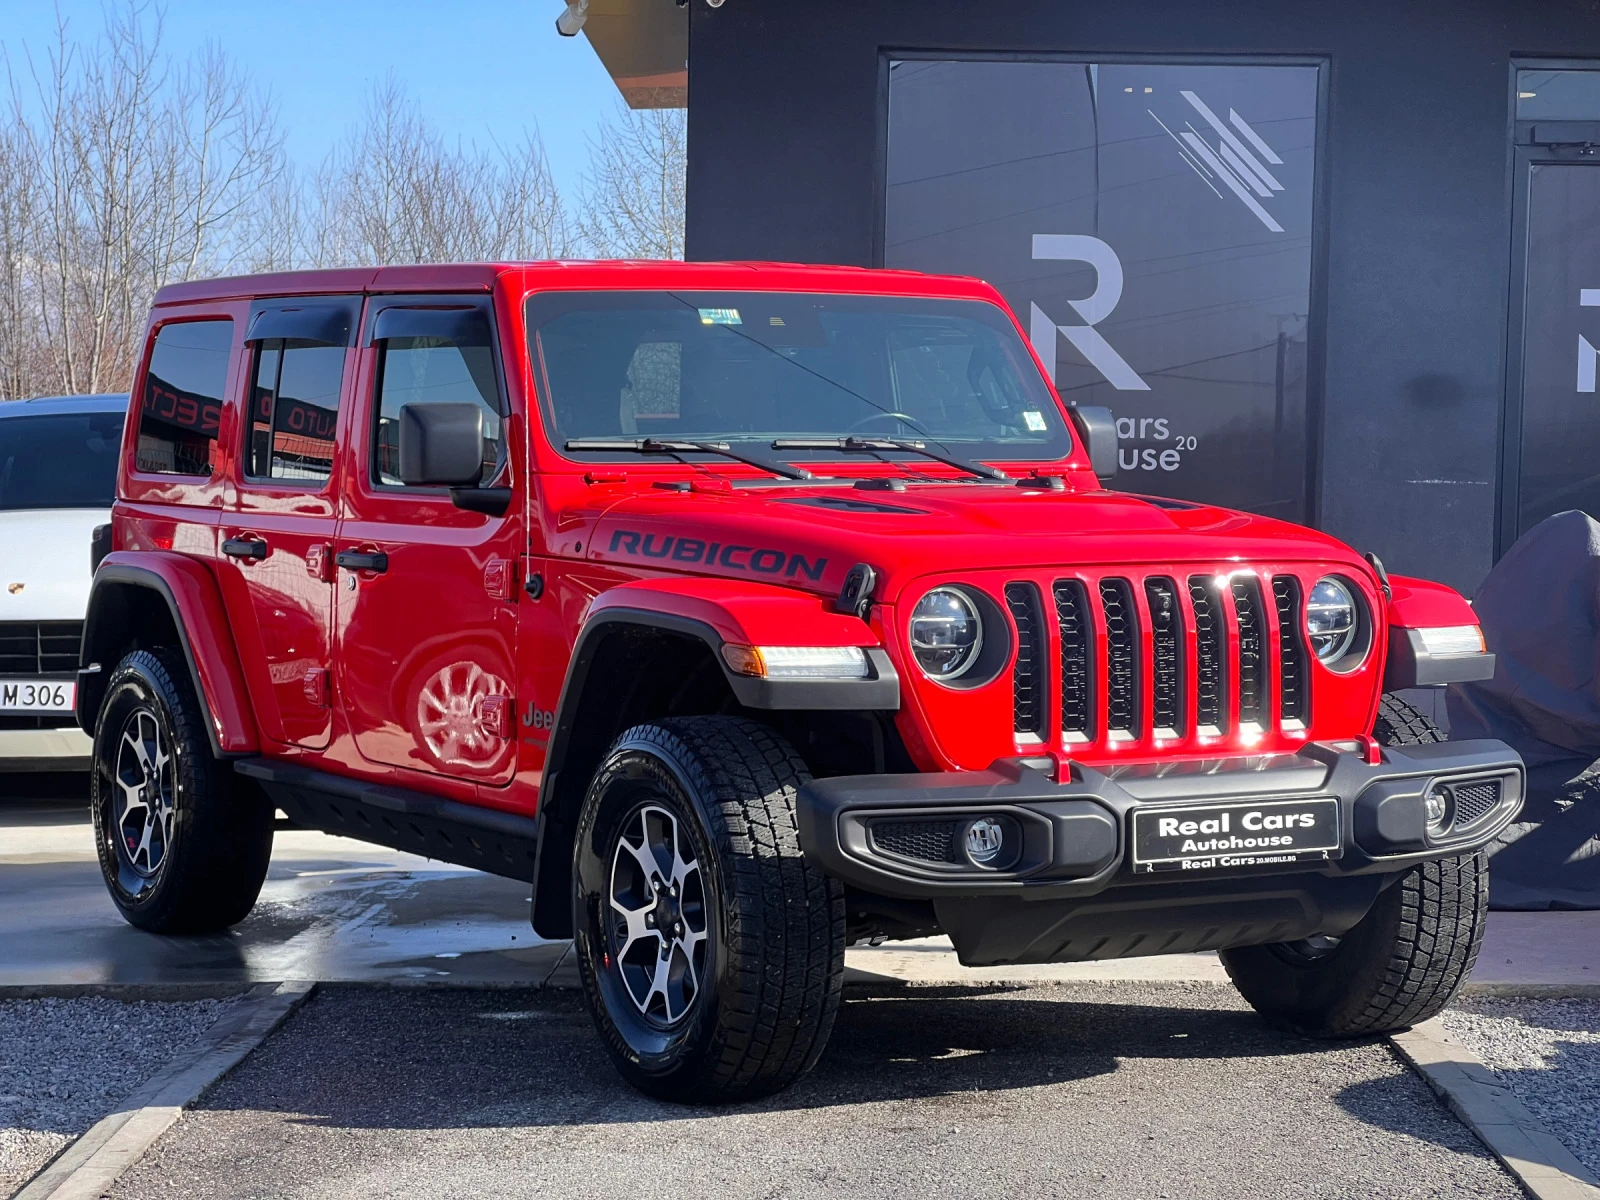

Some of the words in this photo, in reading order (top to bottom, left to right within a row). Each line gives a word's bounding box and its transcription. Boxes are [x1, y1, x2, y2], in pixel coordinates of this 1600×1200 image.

[1030, 233, 1152, 391] R
[1115, 416, 1170, 440] ars
[1175, 435, 1198, 451] 20
[1118, 448, 1181, 471] use
[608, 529, 829, 582] RUBICON
[522, 700, 555, 730] Jee
[1158, 813, 1230, 837] Real
[1241, 811, 1316, 831] Cars
[1181, 835, 1293, 853] Autohouse
[1181, 857, 1217, 870] Real
[1219, 856, 1256, 867] Cars
